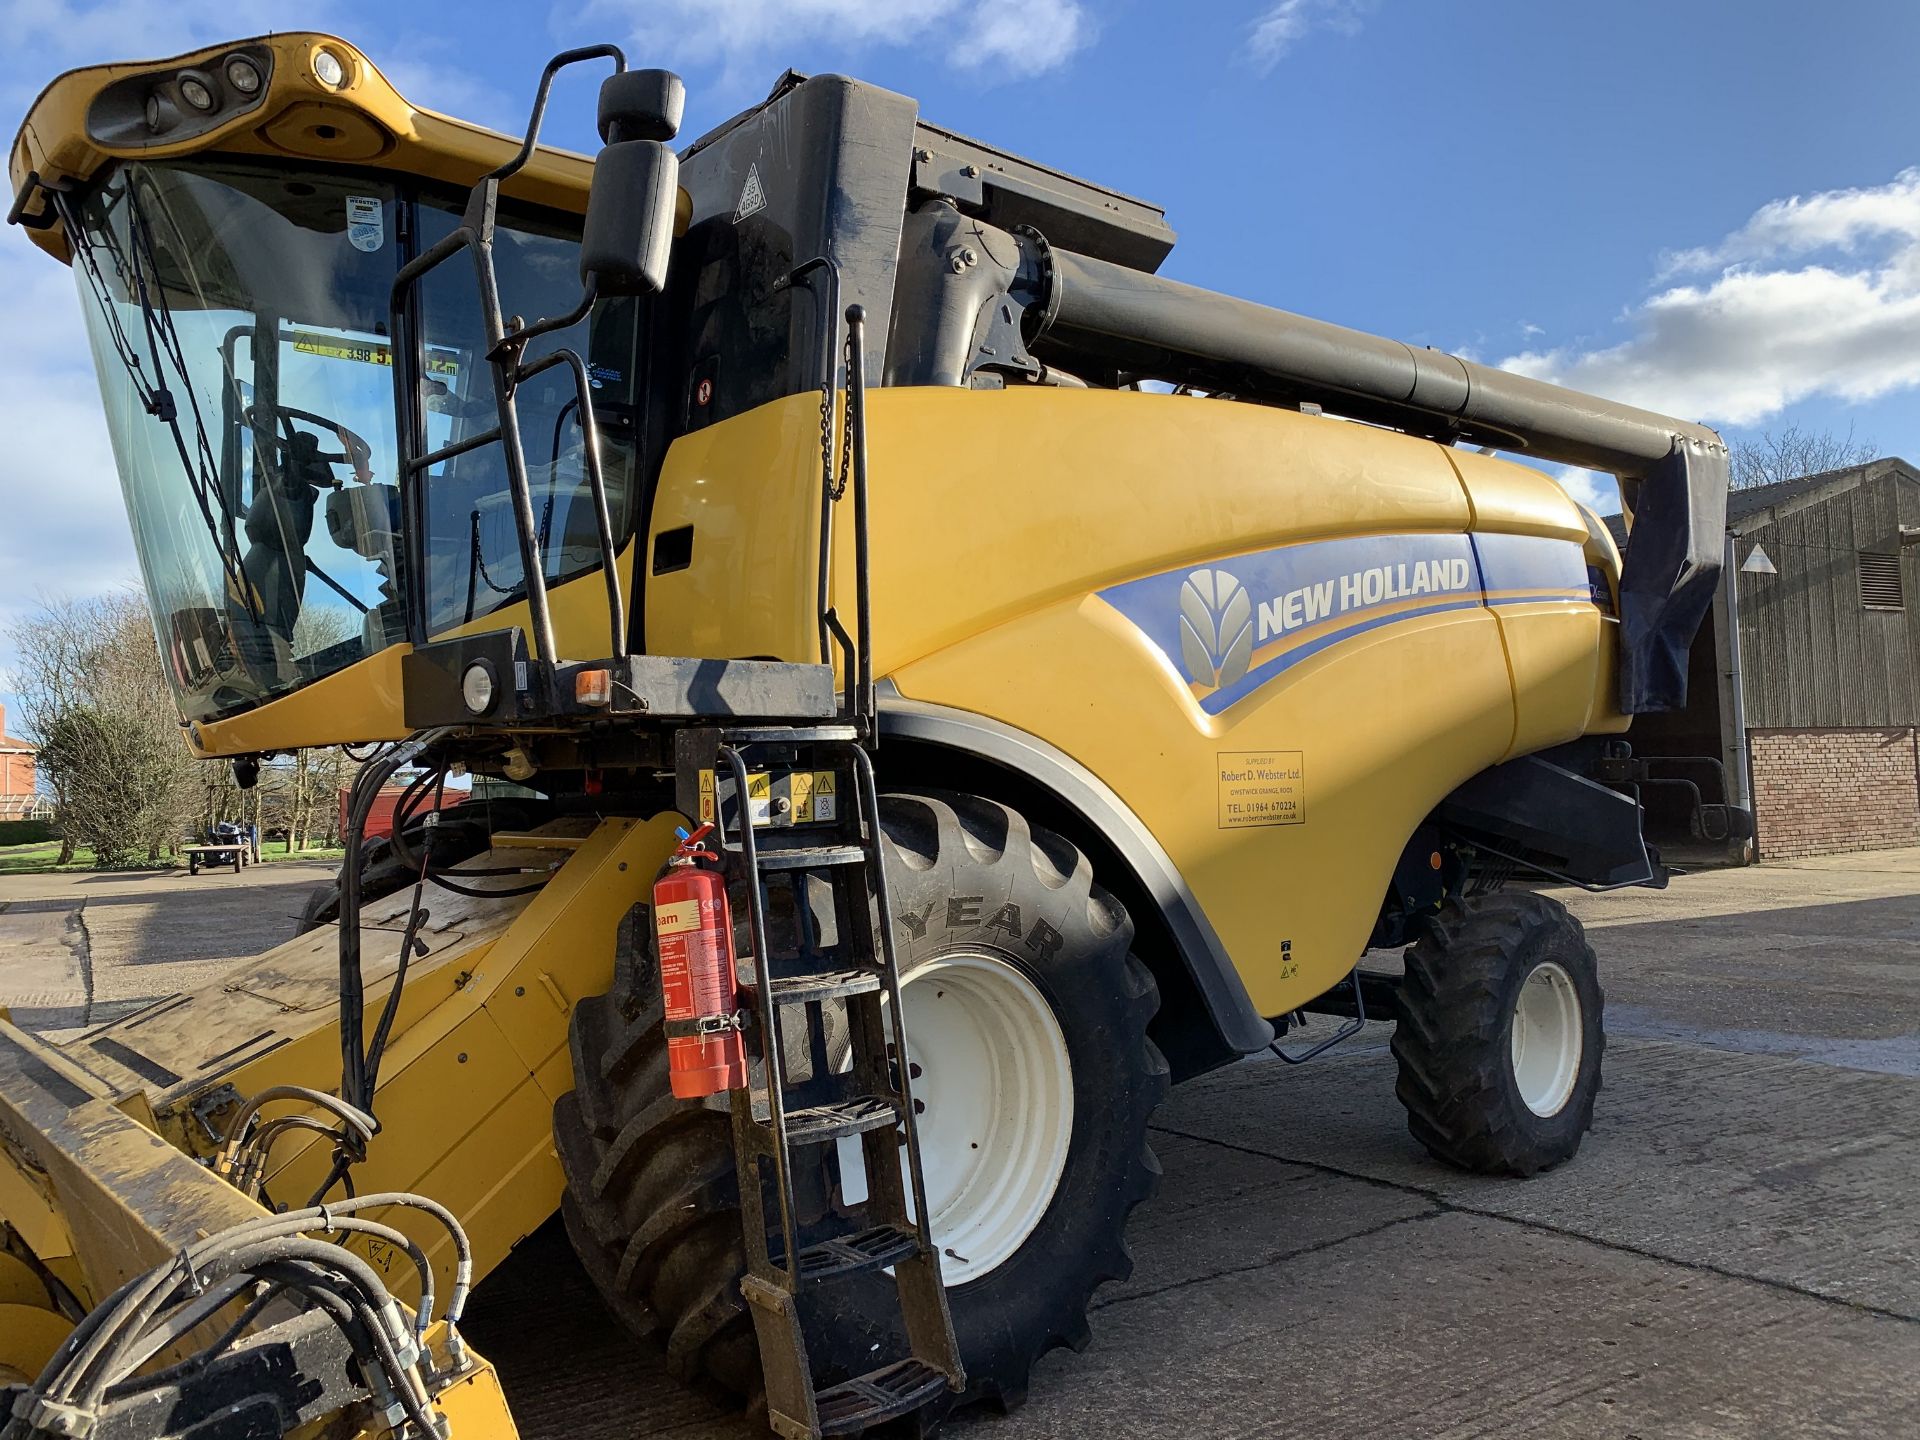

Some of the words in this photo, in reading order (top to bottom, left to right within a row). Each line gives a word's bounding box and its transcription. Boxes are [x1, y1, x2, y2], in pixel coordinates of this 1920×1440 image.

[1258, 580, 1334, 641] NEW
[1340, 558, 1470, 612] HOLLAND
[1221, 769, 1246, 781] Robert
[1247, 769, 1256, 780] D.
[1256, 769, 1286, 780] Webster
[1246, 802, 1268, 812] 01964
[1271, 801, 1297, 811] 670224
[885, 896, 1064, 961] YEAR
